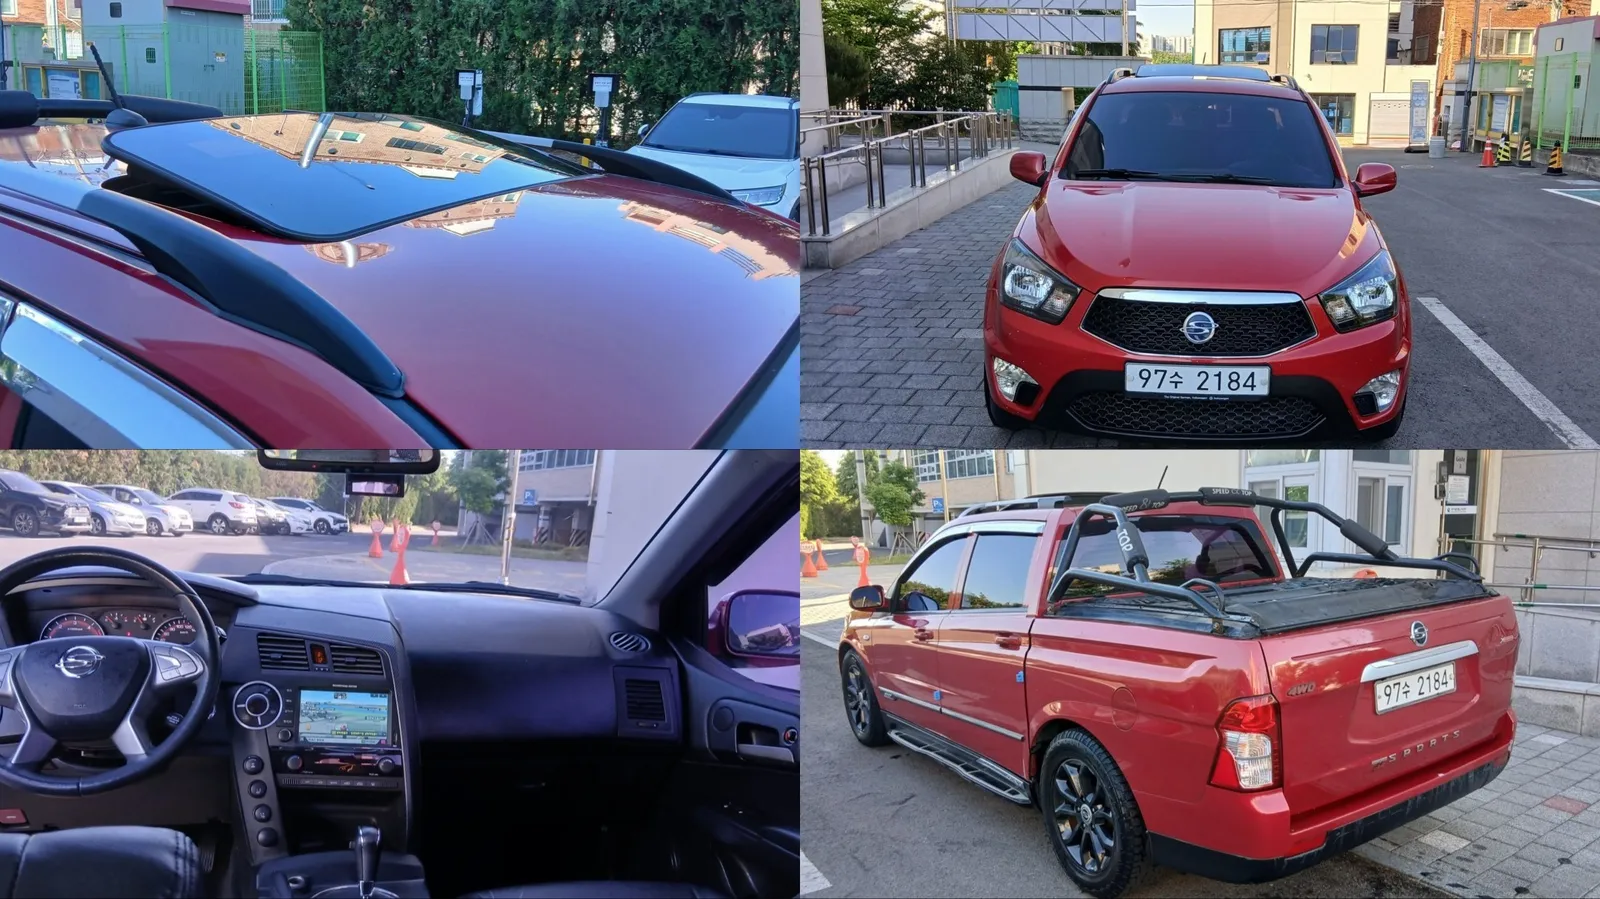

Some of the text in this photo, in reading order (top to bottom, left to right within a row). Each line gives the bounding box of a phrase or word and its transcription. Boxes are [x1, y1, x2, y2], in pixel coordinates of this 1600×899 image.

[1138, 368, 1257, 392] 97수 2184
[1119, 504, 1138, 513] PEED
[1152, 501, 1165, 509] TOP
[1117, 528, 1134, 552] TOP
[1286, 681, 1317, 697] 4WD
[1383, 669, 1449, 705] 97수 2184
[1388, 730, 1460, 763] SPORTS
